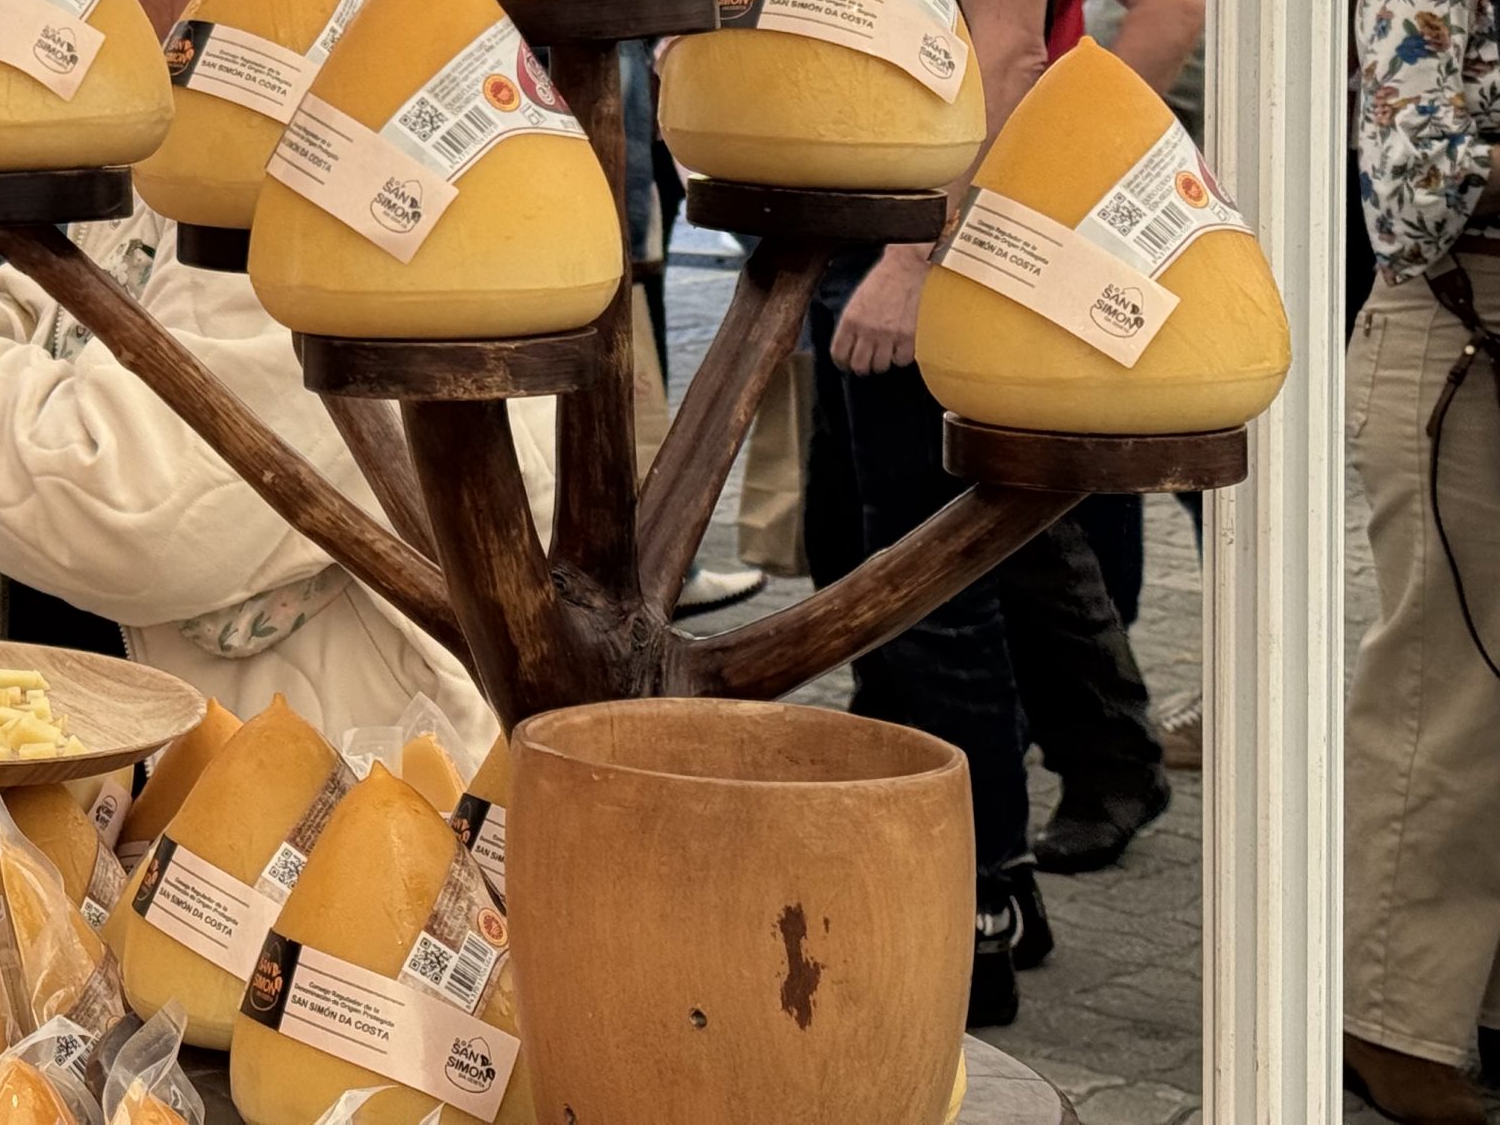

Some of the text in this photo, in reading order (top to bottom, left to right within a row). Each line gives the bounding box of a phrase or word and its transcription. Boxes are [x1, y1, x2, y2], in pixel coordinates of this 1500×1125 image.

[825, 7, 839, 18] DA
[840, 11, 874, 29] COSTA
[201, 59, 216, 69] SAN
[245, 74, 257, 84] DA
[258, 78, 287, 96] COSTA
[308, 152, 332, 173] COSTA
[382, 180, 410, 205] SAN
[959, 231, 972, 244] SAN
[997, 248, 1009, 260] DA
[1009, 255, 1042, 277] COSTA
[1102, 287, 1131, 310] SAN
[475, 845, 505, 863] SAN SIM
[159, 887, 170, 900] SAN
[192, 910, 204, 921] DA
[204, 916, 233, 938] COSTA
[291, 994, 390, 1041] SAN SIMÓN DA COSTA
[451, 1043, 479, 1063] SAN
